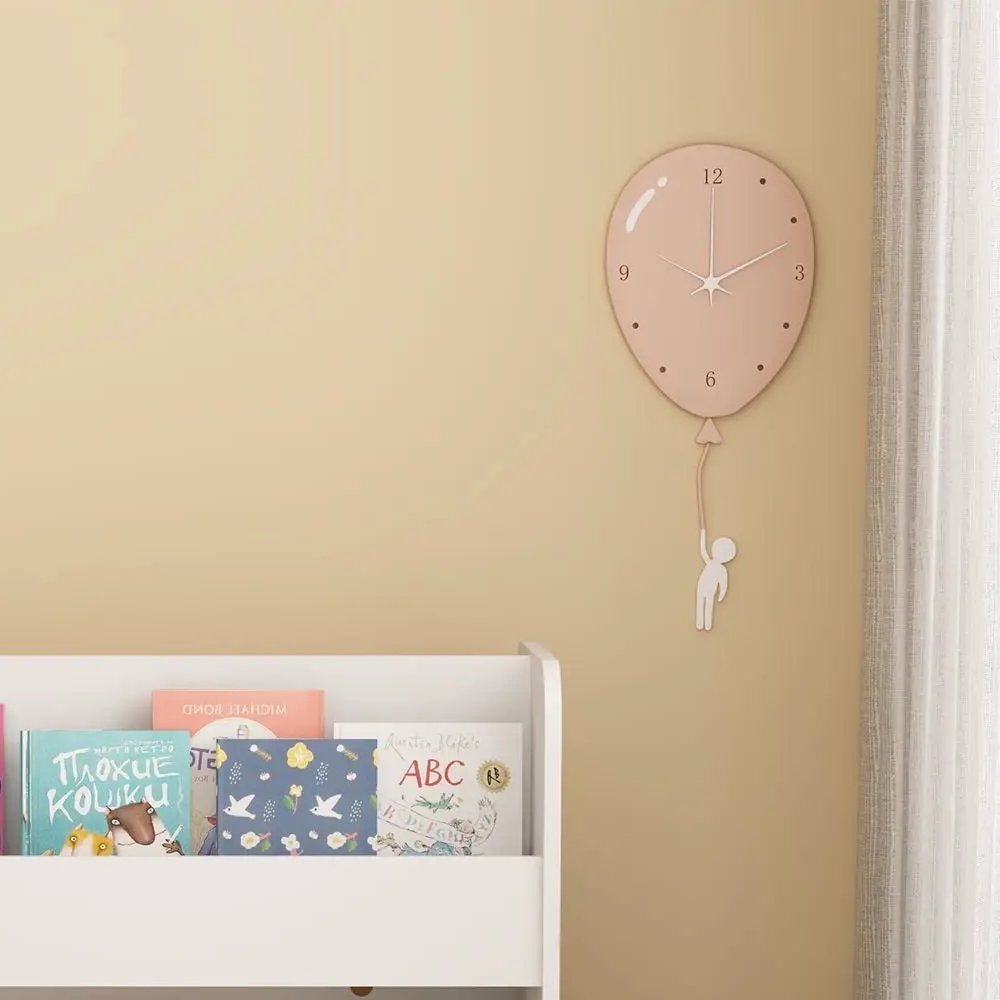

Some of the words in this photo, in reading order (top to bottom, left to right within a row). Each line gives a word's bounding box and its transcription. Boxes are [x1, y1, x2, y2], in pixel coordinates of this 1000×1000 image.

[703, 168, 723, 185] 12
[619, 264, 630, 281] 9
[794, 264, 805, 281] 3
[705, 371, 716, 388] 6
[399, 759, 465, 788] ABC
